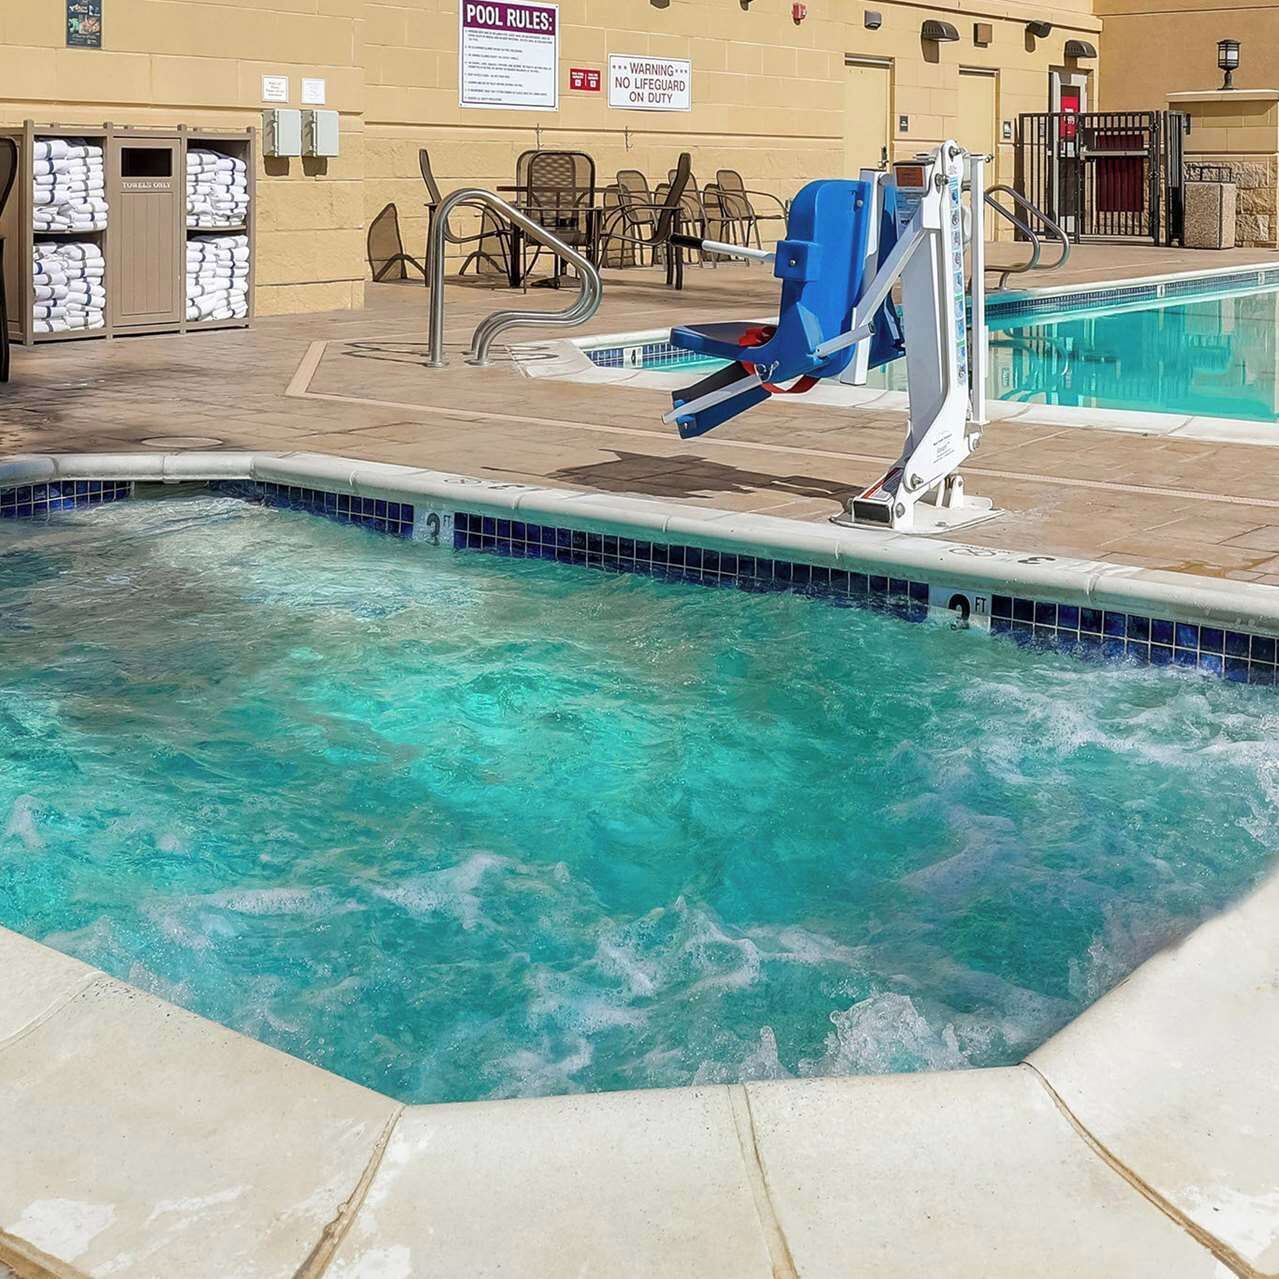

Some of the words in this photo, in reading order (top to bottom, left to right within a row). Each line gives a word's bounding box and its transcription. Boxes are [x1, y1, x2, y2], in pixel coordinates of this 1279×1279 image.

[466, 3, 503, 26] POOL
[507, 8, 553, 31] RULES:
[629, 61, 674, 77] WARNING
[615, 76, 631, 89] NO
[634, 77, 686, 92] LIFEGUARD
[629, 90, 644, 103] ON
[648, 92, 673, 104] DUTY
[975, 596, 986, 613] FT
